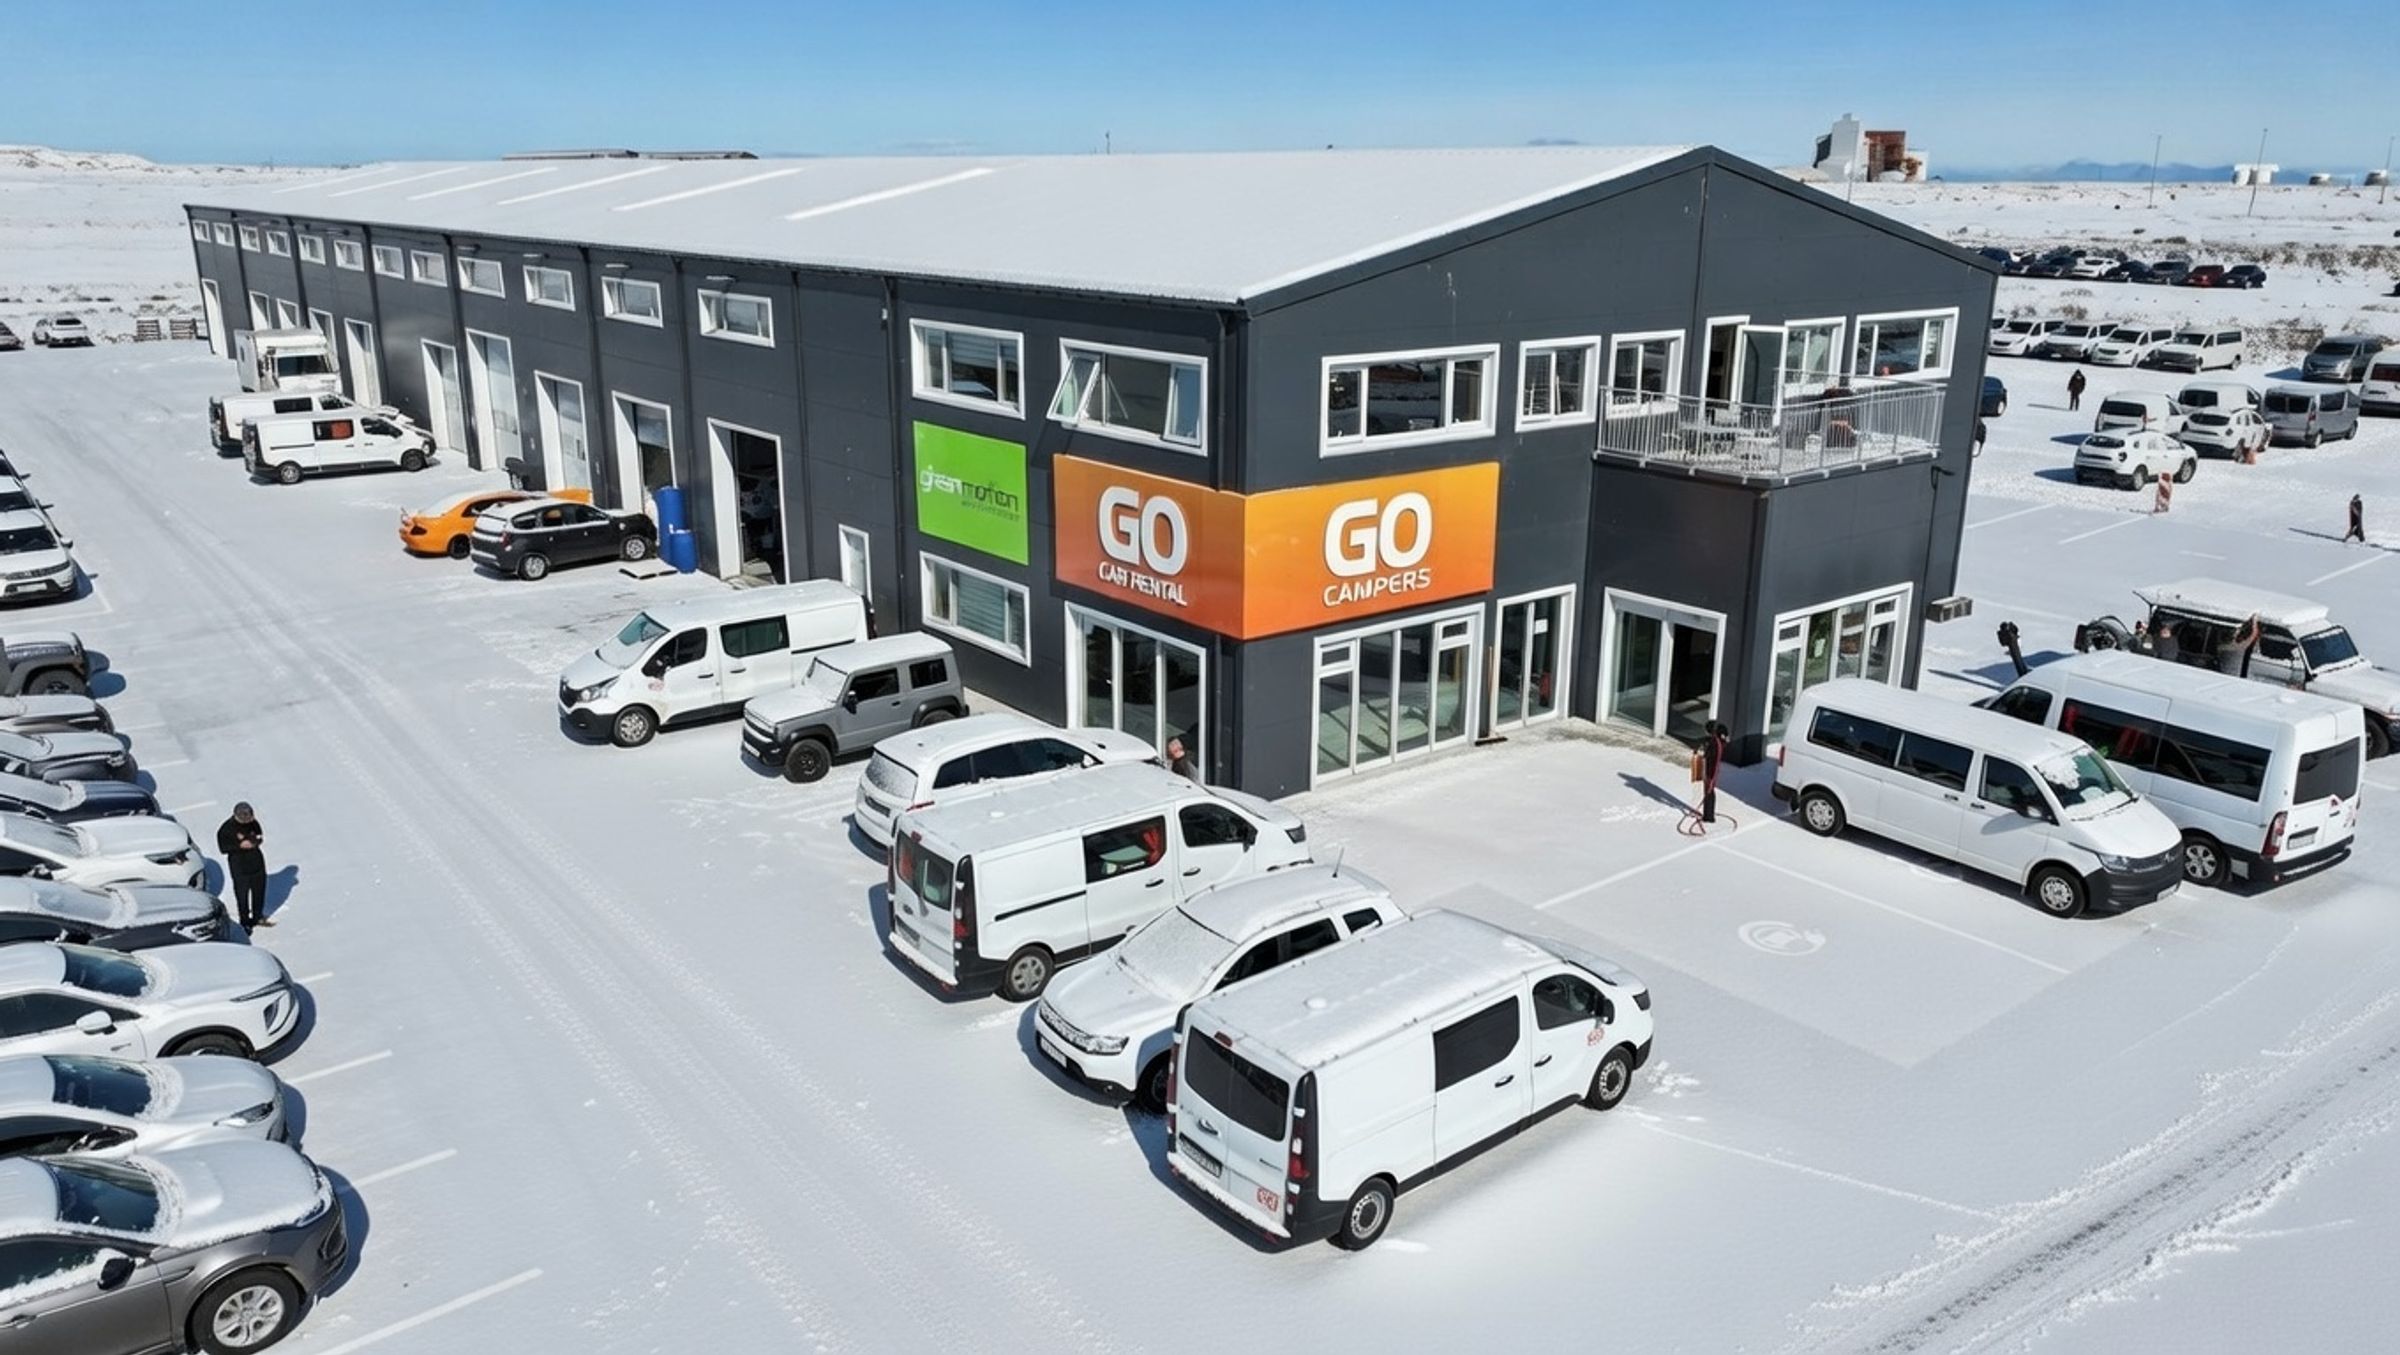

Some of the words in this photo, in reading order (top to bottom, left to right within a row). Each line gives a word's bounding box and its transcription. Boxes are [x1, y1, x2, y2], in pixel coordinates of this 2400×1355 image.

[1098, 485, 1188, 576] GO
[1324, 491, 1433, 577] GO
[1099, 561, 1128, 587] CAR
[1130, 571, 1188, 606] RENTAL
[1323, 568, 1432, 607] CAMPERS
